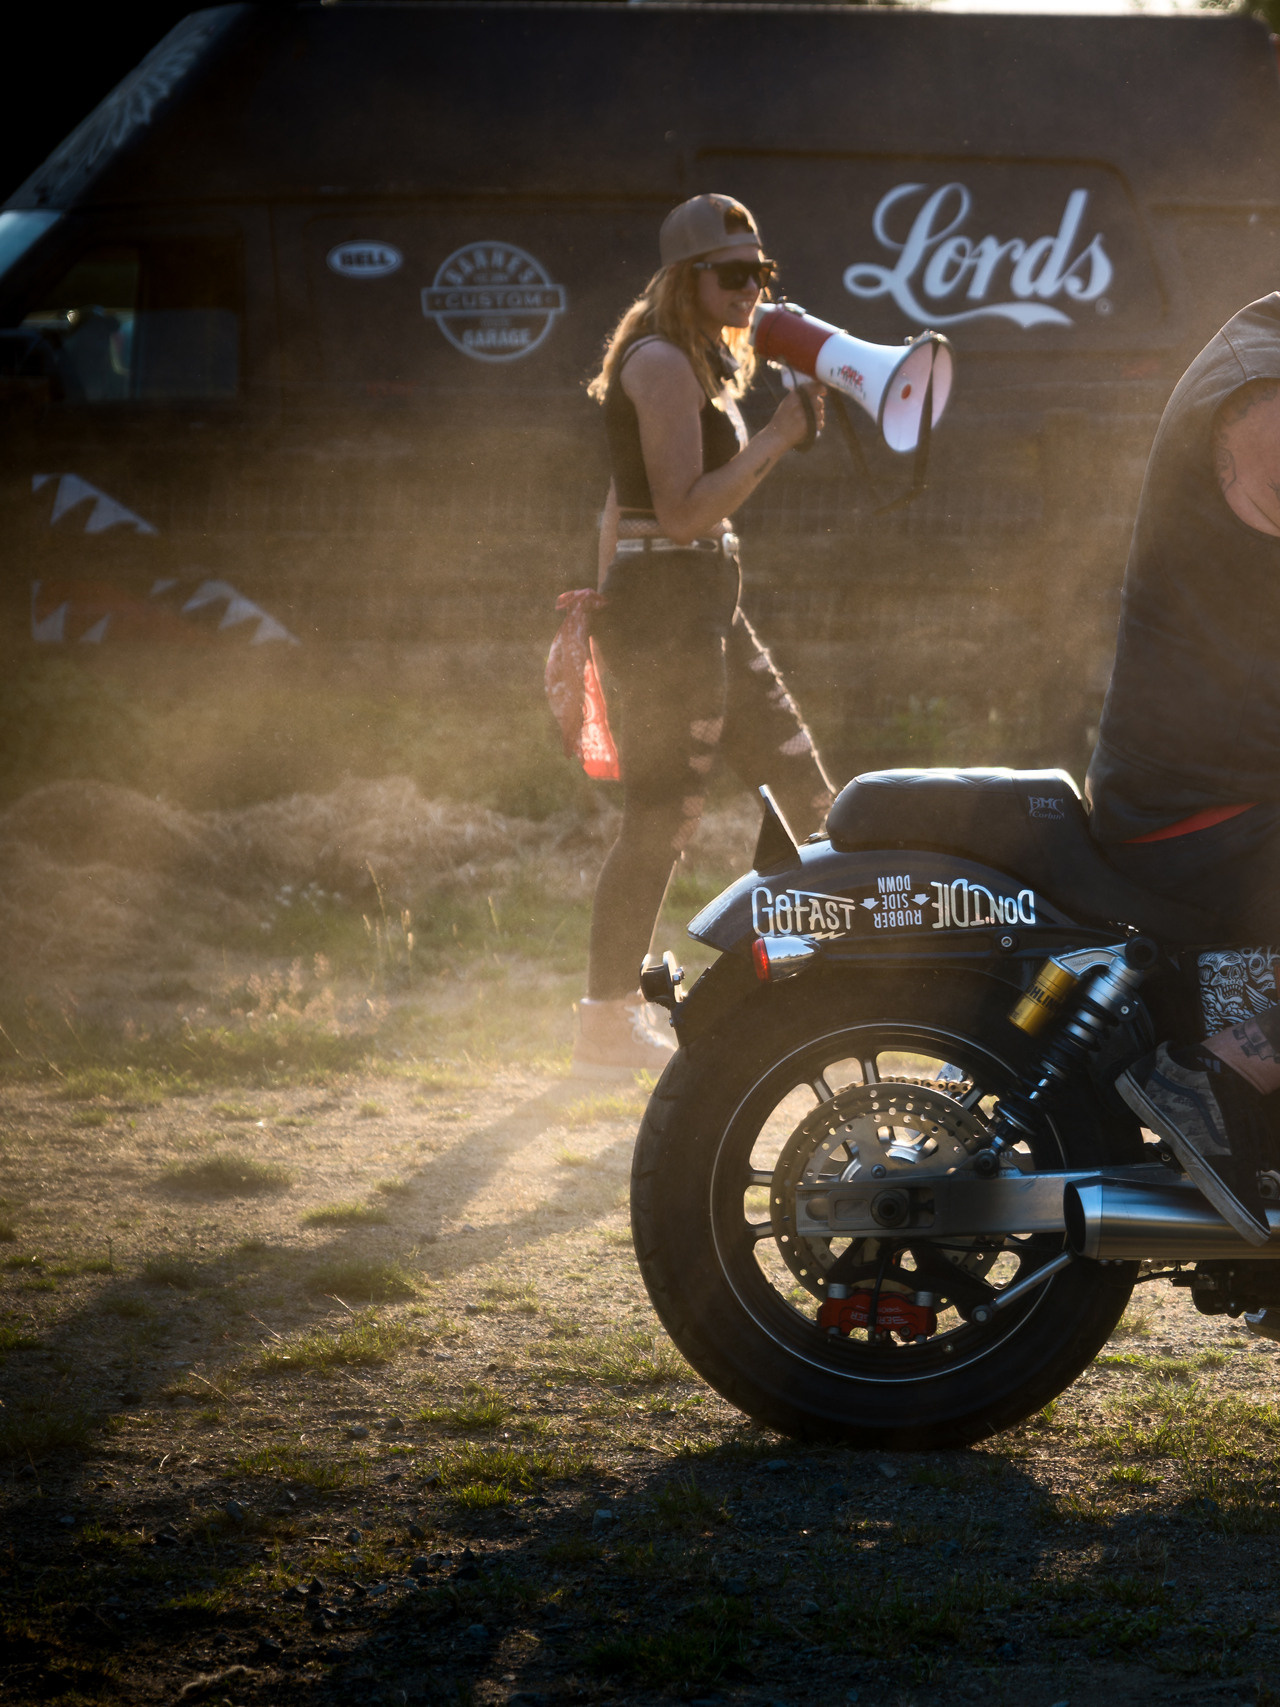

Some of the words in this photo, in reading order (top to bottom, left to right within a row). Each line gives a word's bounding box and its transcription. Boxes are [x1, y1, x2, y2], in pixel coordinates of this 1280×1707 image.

[340, 251, 391, 266] BELL
[843, 182, 1113, 328] Lords
[446, 292, 542, 309] CUSTOM
[462, 329, 530, 346] GARAGE
[1028, 796, 1064, 815] BMC
[877, 875, 911, 893] DOWN
[881, 893, 908, 909] SIDE
[873, 909, 922, 929] RUBBER
[850, 1311, 909, 1325] BERIGER
